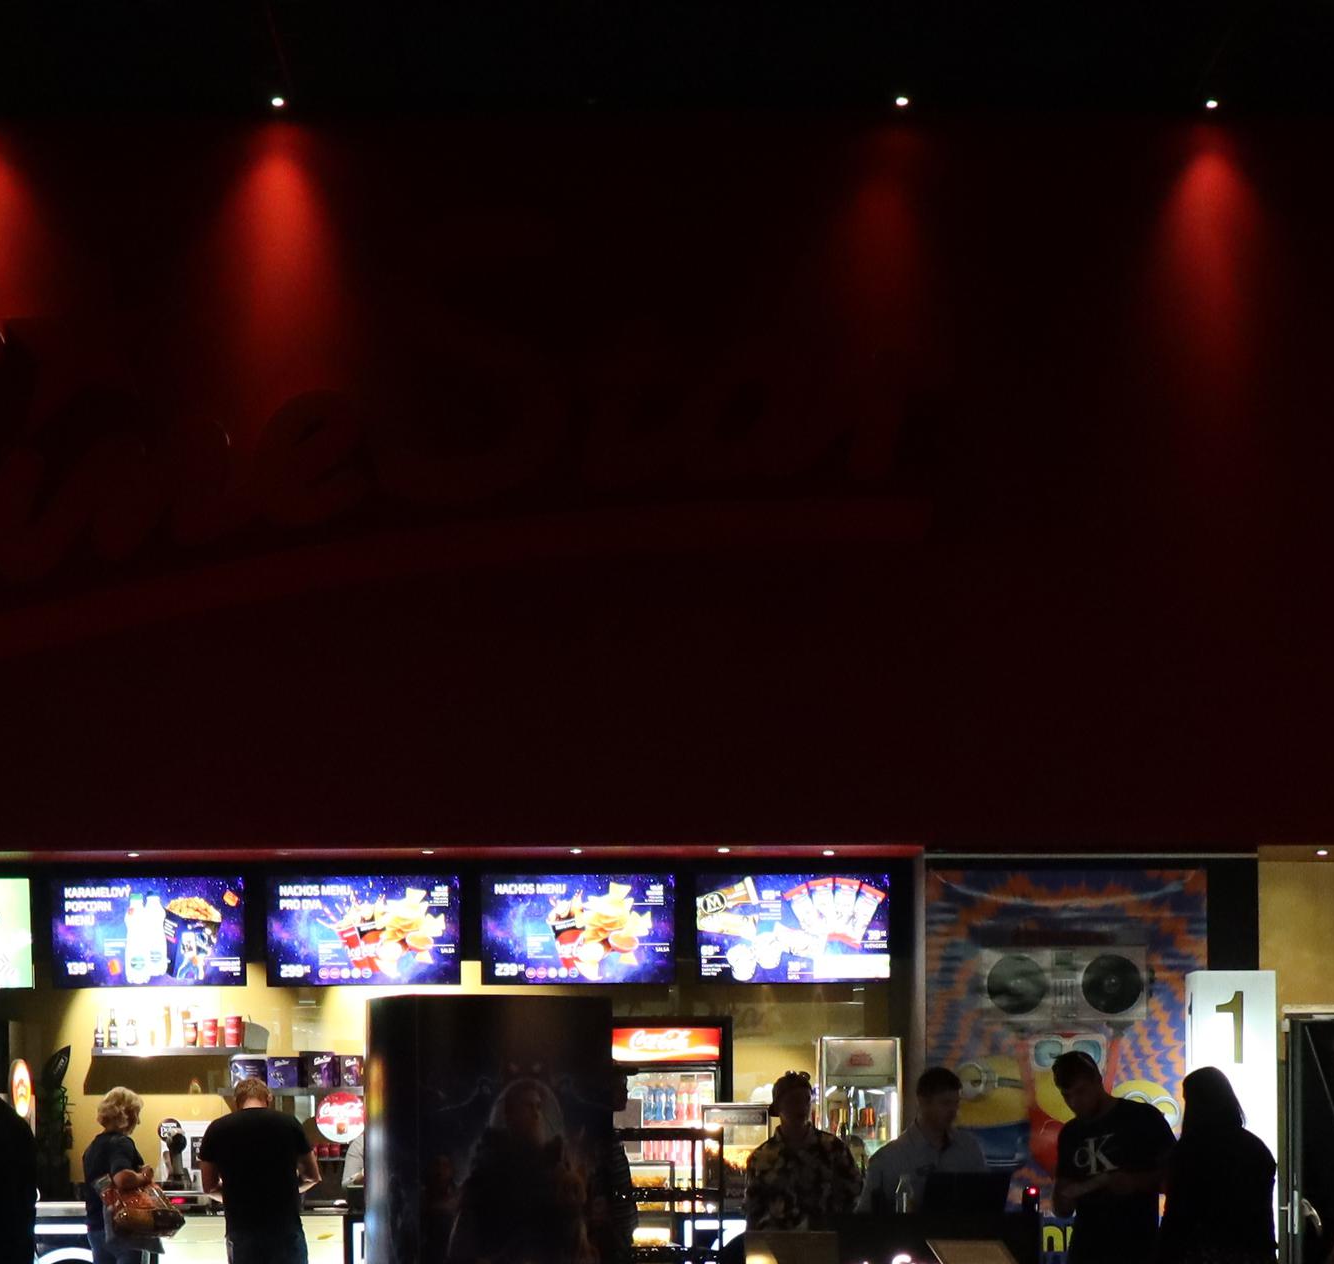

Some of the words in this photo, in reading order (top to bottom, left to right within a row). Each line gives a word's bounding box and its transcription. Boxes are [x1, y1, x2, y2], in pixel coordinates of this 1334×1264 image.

[64, 884, 131, 898] KARAMELOVÝ
[279, 885, 320, 897] NACHOS
[321, 884, 351, 896] MENU
[494, 883, 535, 895] NACHOS
[536, 883, 567, 895] MENU
[65, 901, 112, 912] POPCORN
[279, 899, 300, 910] PRO
[302, 899, 323, 910] DVA
[65, 914, 95, 926] MENU
[495, 963, 518, 976] 239
[1215, 990, 1244, 1064] 1
